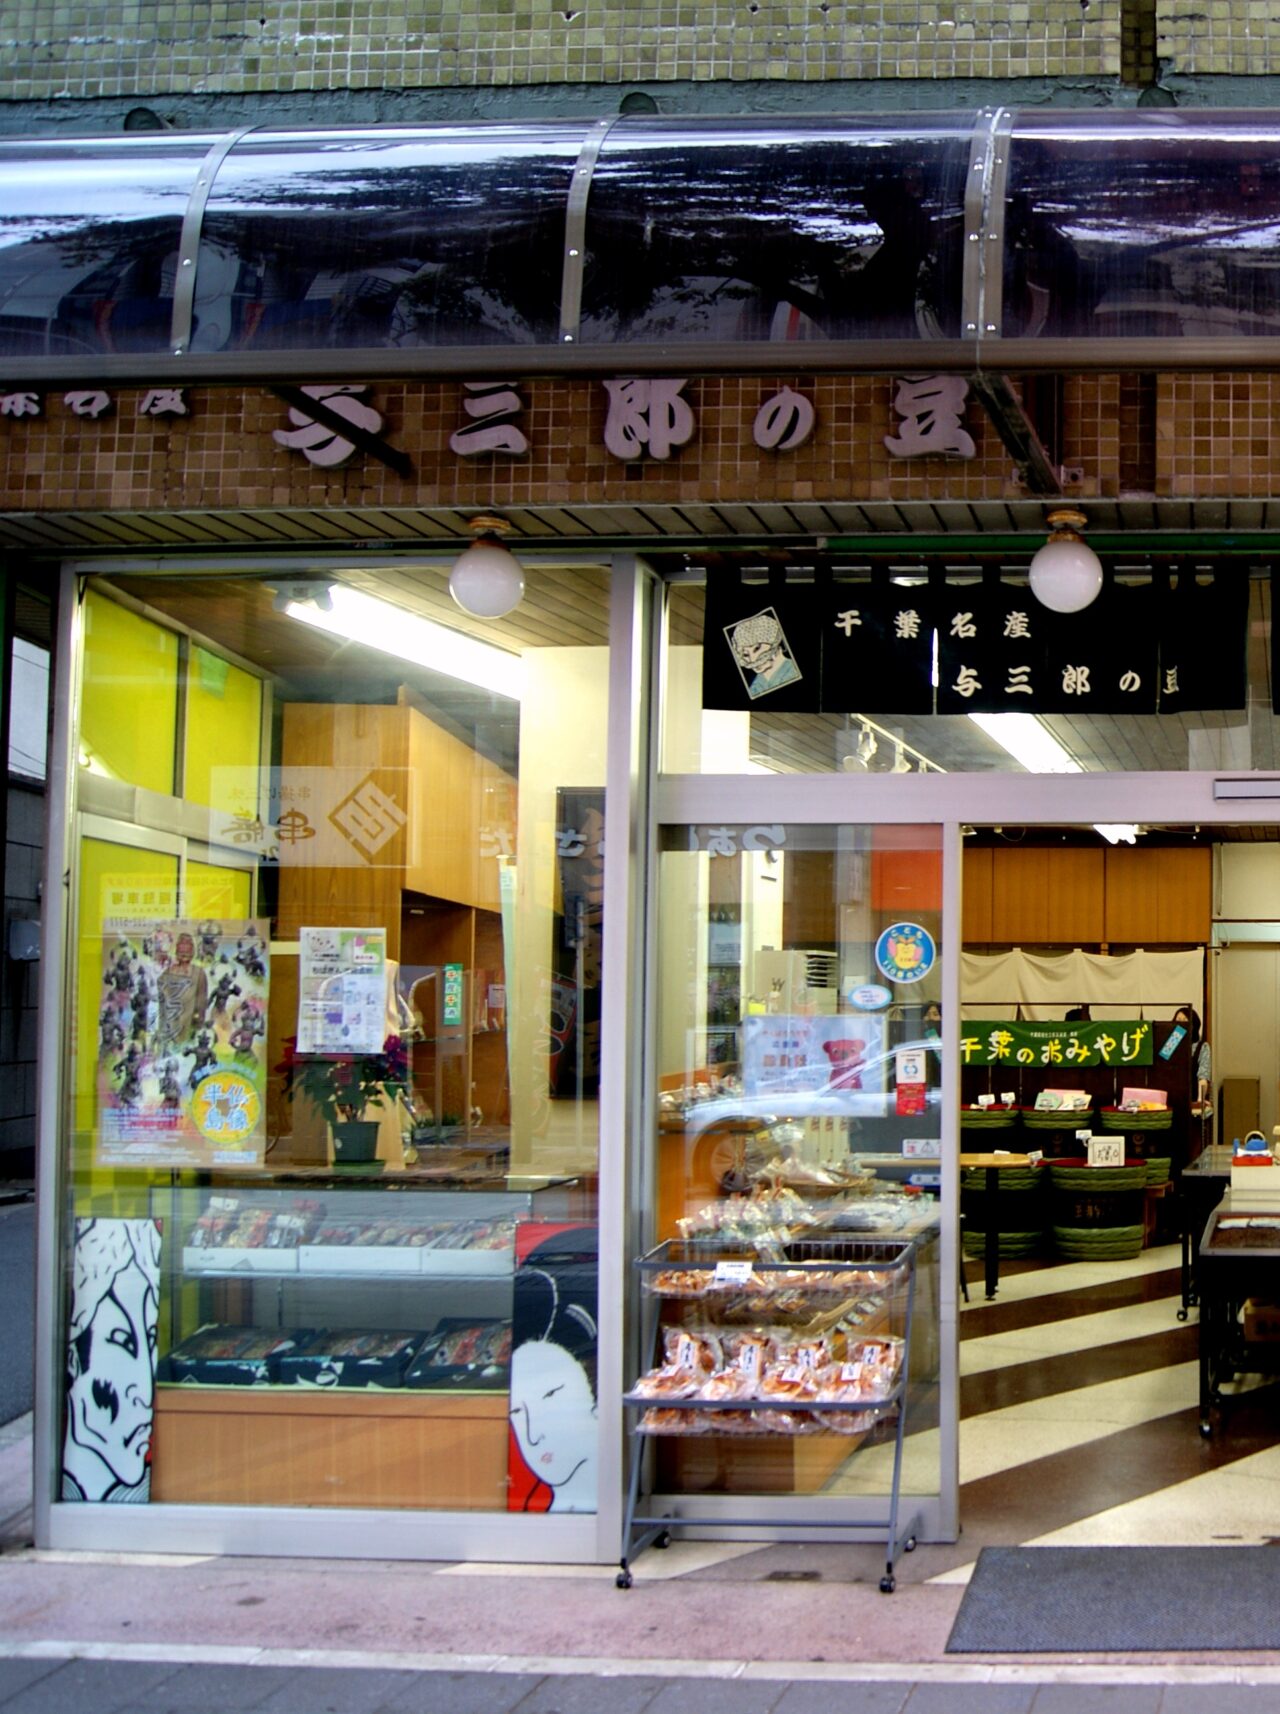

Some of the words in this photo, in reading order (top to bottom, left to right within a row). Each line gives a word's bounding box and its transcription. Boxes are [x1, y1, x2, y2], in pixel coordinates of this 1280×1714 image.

[833, 609, 1032, 639] 千葉名産
[959, 1024, 1149, 1066] 千葉のおみやげ
